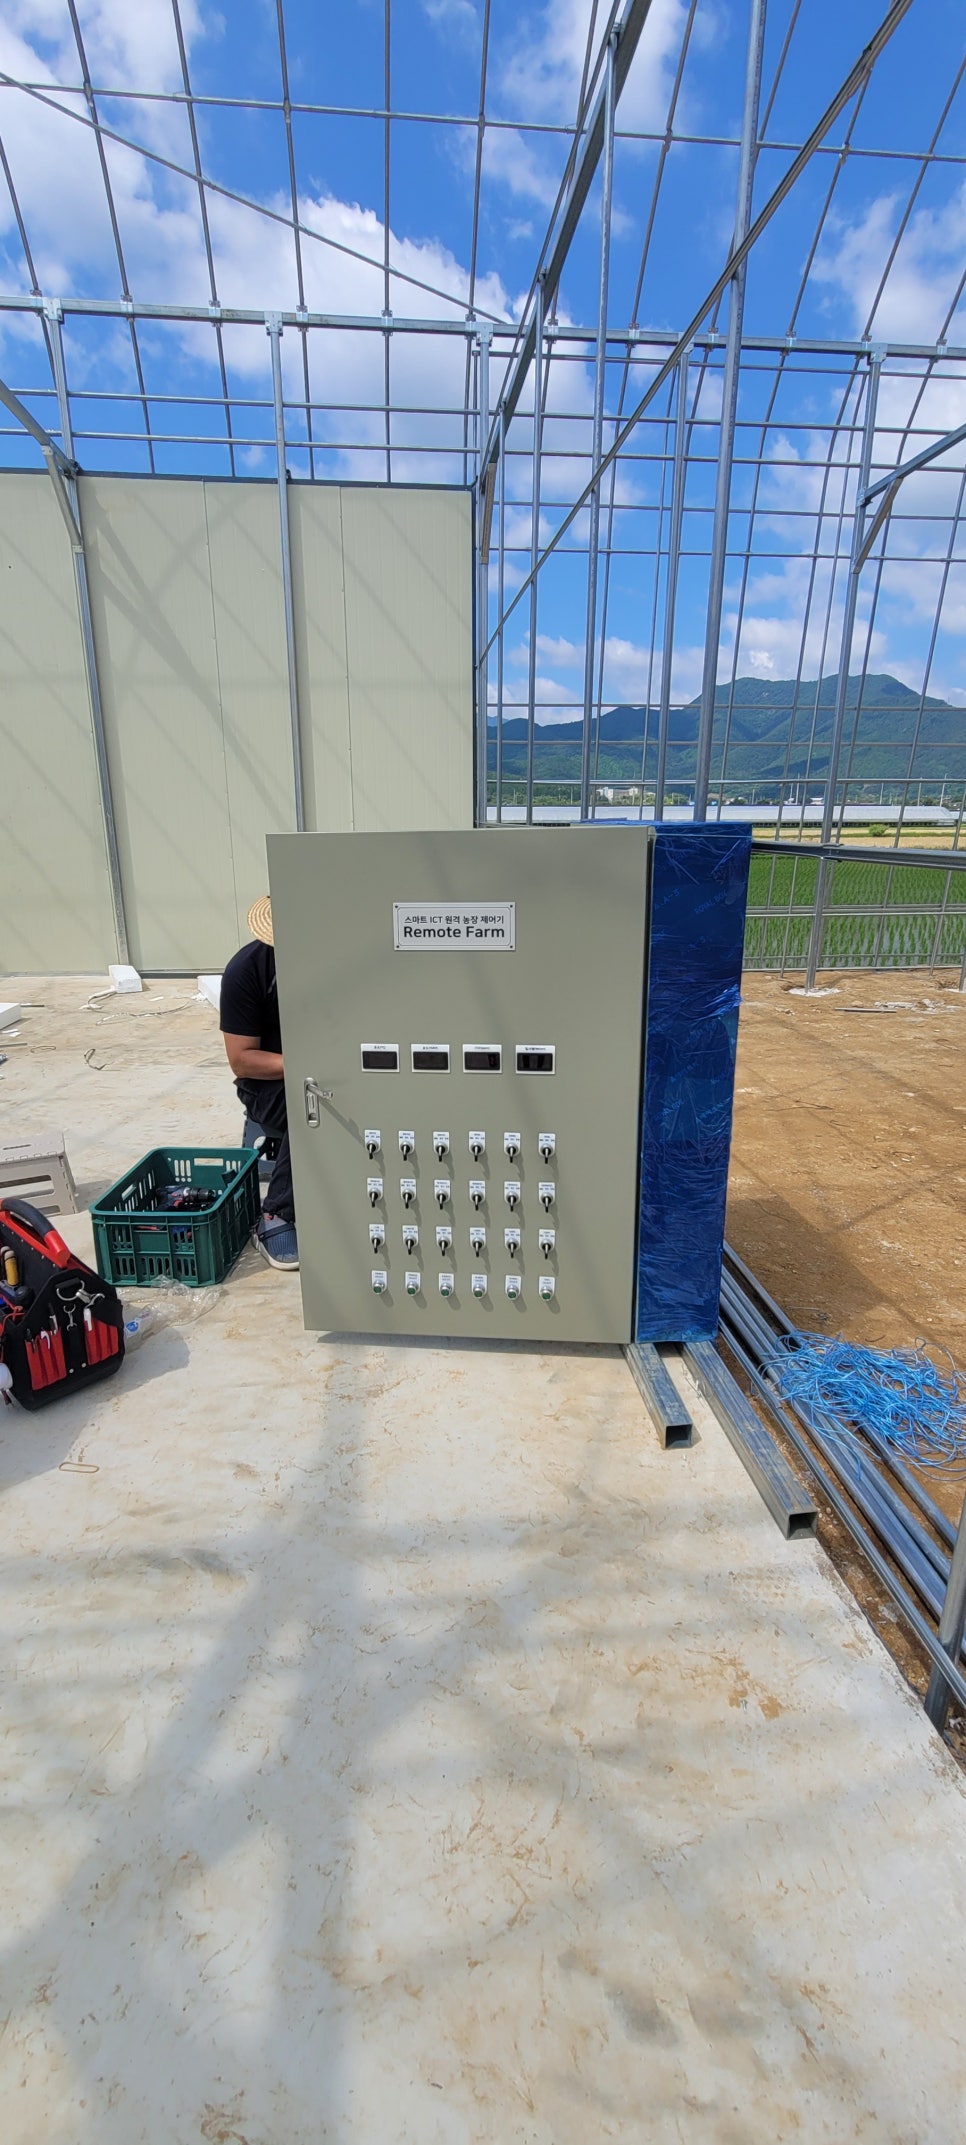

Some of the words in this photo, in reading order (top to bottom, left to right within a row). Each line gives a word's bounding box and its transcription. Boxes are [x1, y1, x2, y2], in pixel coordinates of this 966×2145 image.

[404, 915, 428, 924] 스마트
[430, 916, 443, 924] ICT
[445, 915, 461, 924] 원격
[462, 915, 478, 924] 농장
[480, 915, 504, 924] 제어기
[403, 926, 462, 938] Remote
[466, 926, 505, 938] Farm
